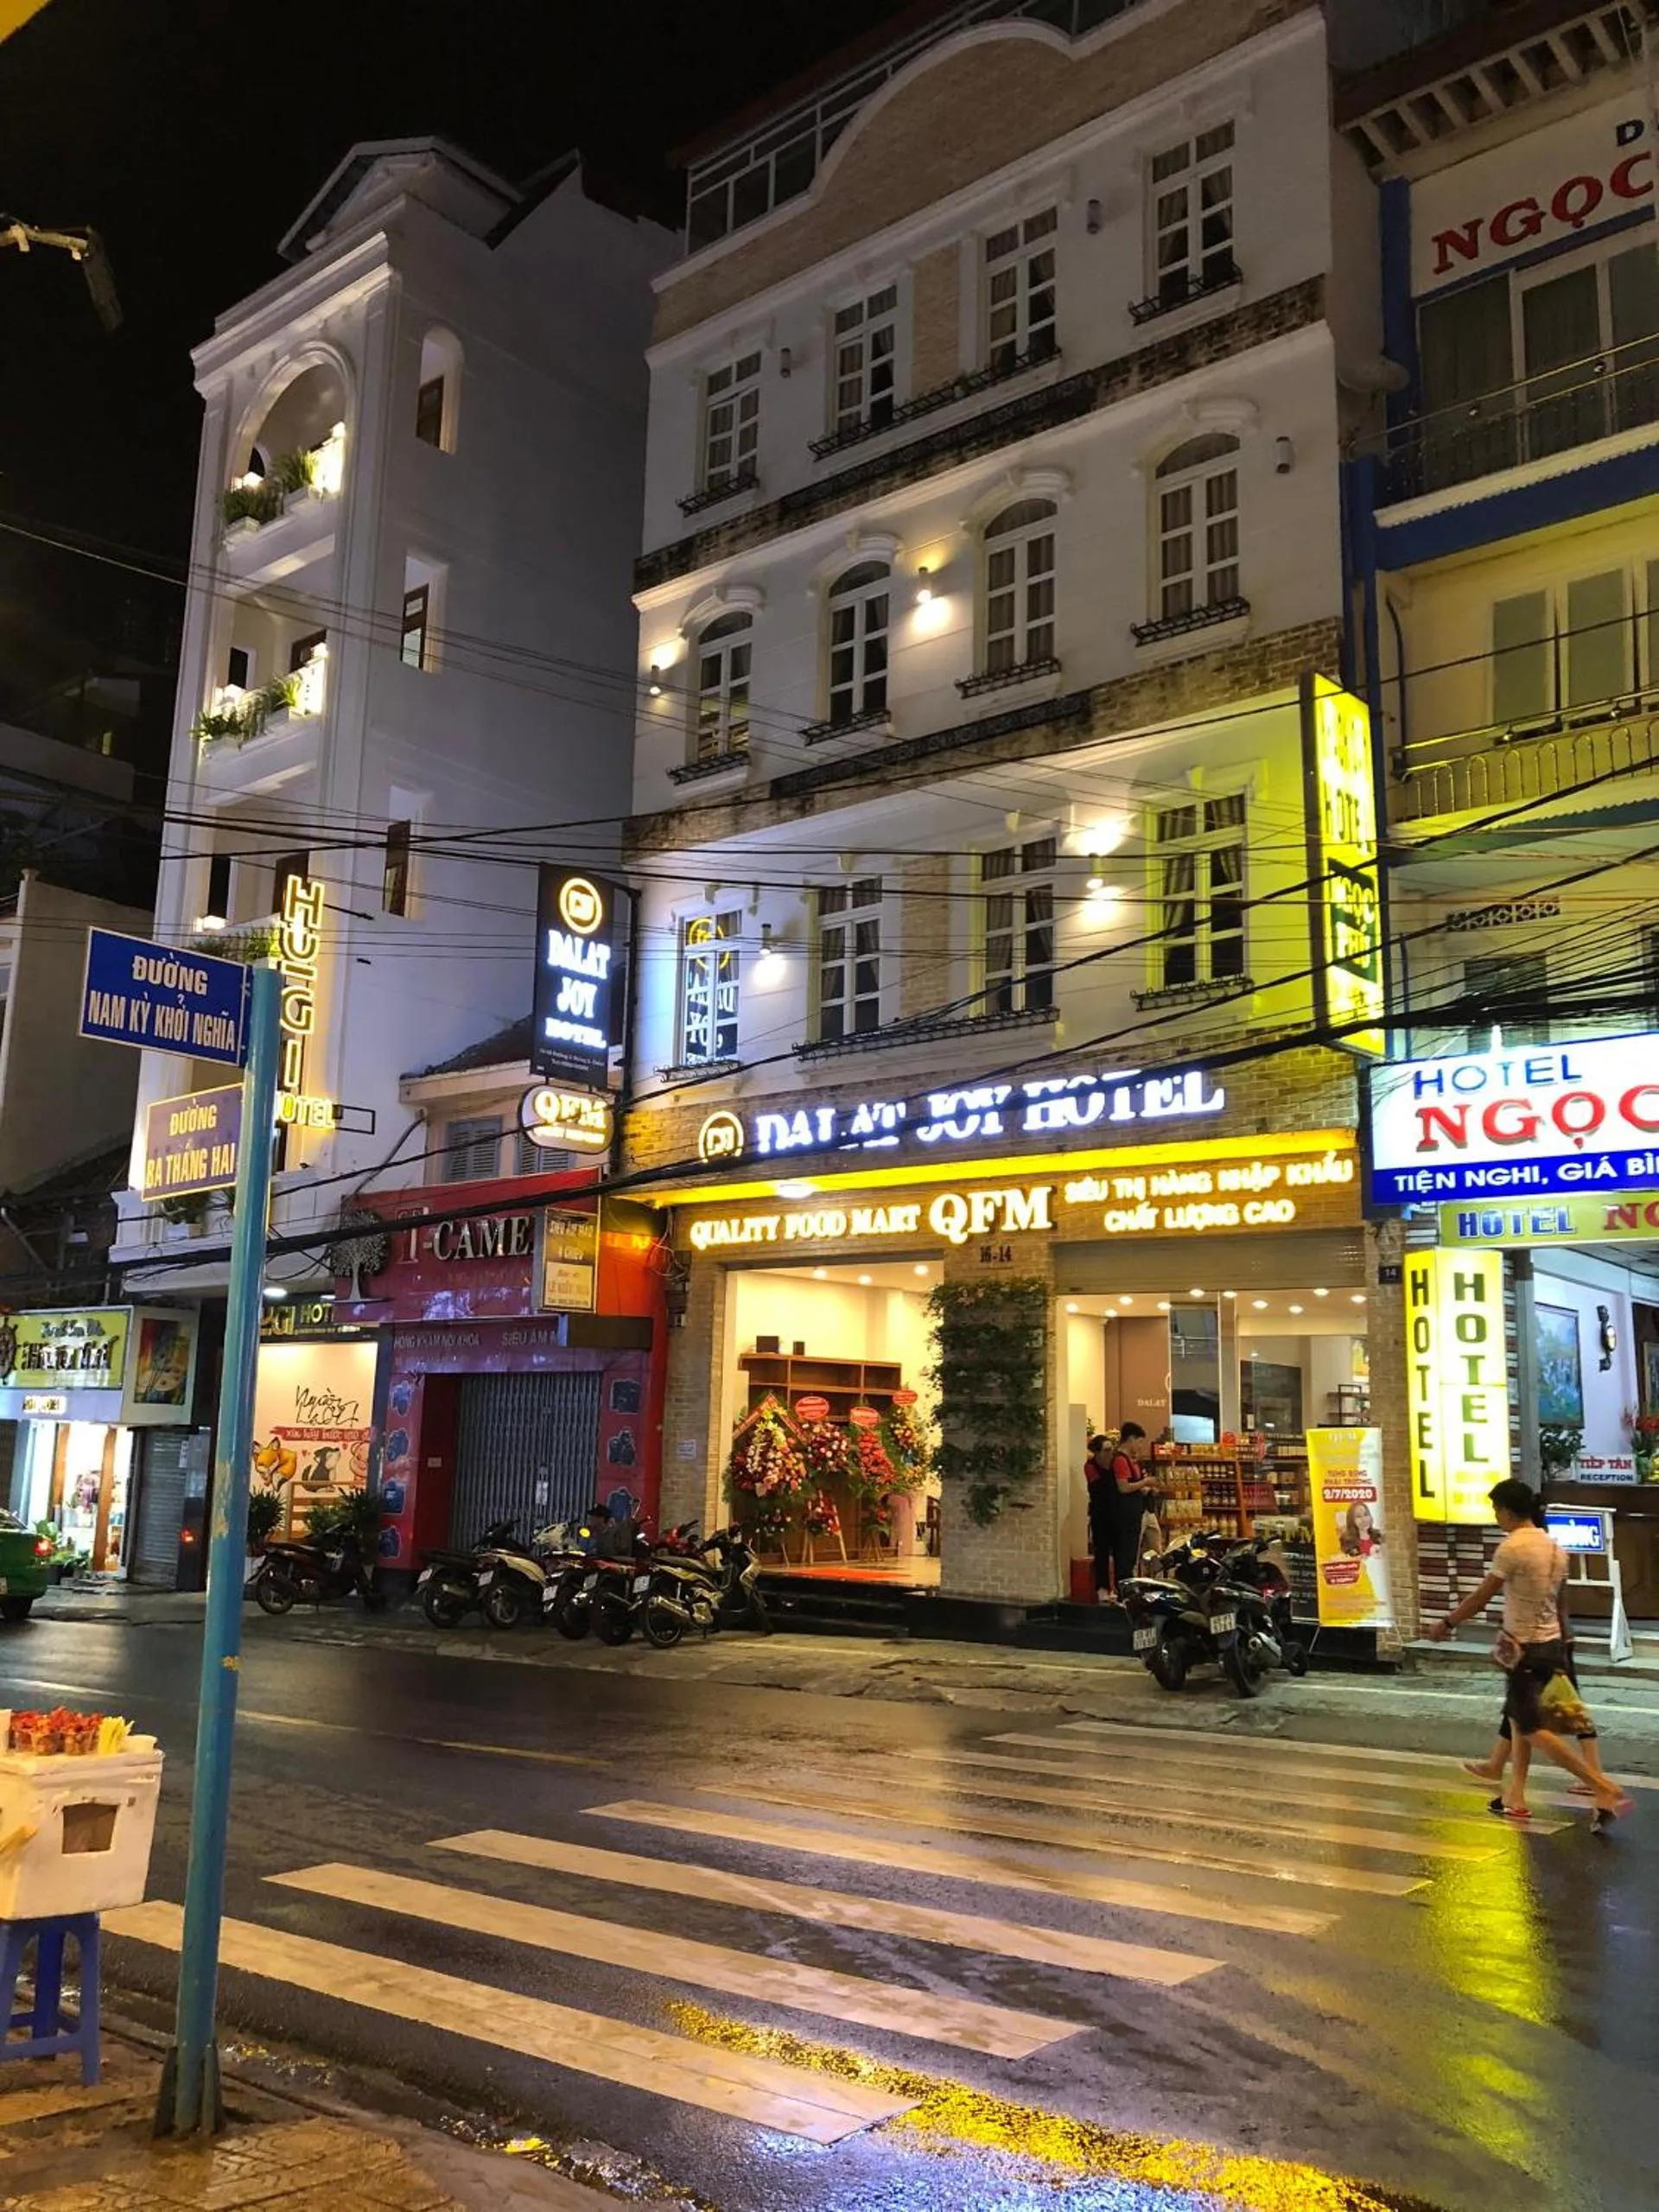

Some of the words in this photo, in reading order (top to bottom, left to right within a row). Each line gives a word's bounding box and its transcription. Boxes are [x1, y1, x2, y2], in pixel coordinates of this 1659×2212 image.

[1431, 151, 1655, 275] NGỌC
[132, 952, 208, 995] ĐƯỜNG
[547, 929, 611, 980] DALAT
[556, 976, 598, 1019] JOY
[88, 990, 126, 1030] NAM
[130, 992, 151, 1034] KỲ
[155, 994, 189, 1042] KHỞI
[193, 1010, 235, 1052] NGHĨA
[1414, 1054, 1582, 1099] HOTEL
[169, 1098, 218, 1136] ĐƯỜNG
[274, 1091, 335, 1129] OTEL
[916, 1085, 1012, 1142] JOY
[1022, 1070, 1225, 1130] HOTEL
[1414, 1084, 1659, 1153] NGỌC
[146, 1159, 162, 1189] BA
[166, 1138, 207, 1185] THÁNG
[210, 1142, 235, 1177] HAI
[1394, 1171, 1462, 1194] TIỆN
[1465, 1166, 1548, 1188] NGHI,
[1558, 1155, 1618, 1181] GIÁ
[1627, 1152, 1659, 1176] BÌ
[1065, 1175, 1108, 1203] SIÊU
[1113, 1176, 1146, 1200] THỊ
[1150, 1169, 1212, 1196] HÀNG
[690, 1215, 782, 1251] QUALITY
[785, 1210, 846, 1239] FOOD
[849, 1205, 921, 1235] MART
[929, 1187, 1053, 1243] QFM
[1243, 1198, 1295, 1224] CAO
[1457, 1205, 1577, 1237] HOTEL
[301, 1303, 335, 1325] HOT
[1410, 1268, 1434, 1499] HOTEL
[1452, 1272, 1491, 1464] HOTEL
[1324, 1488, 1373, 1499] 2/7/2020
